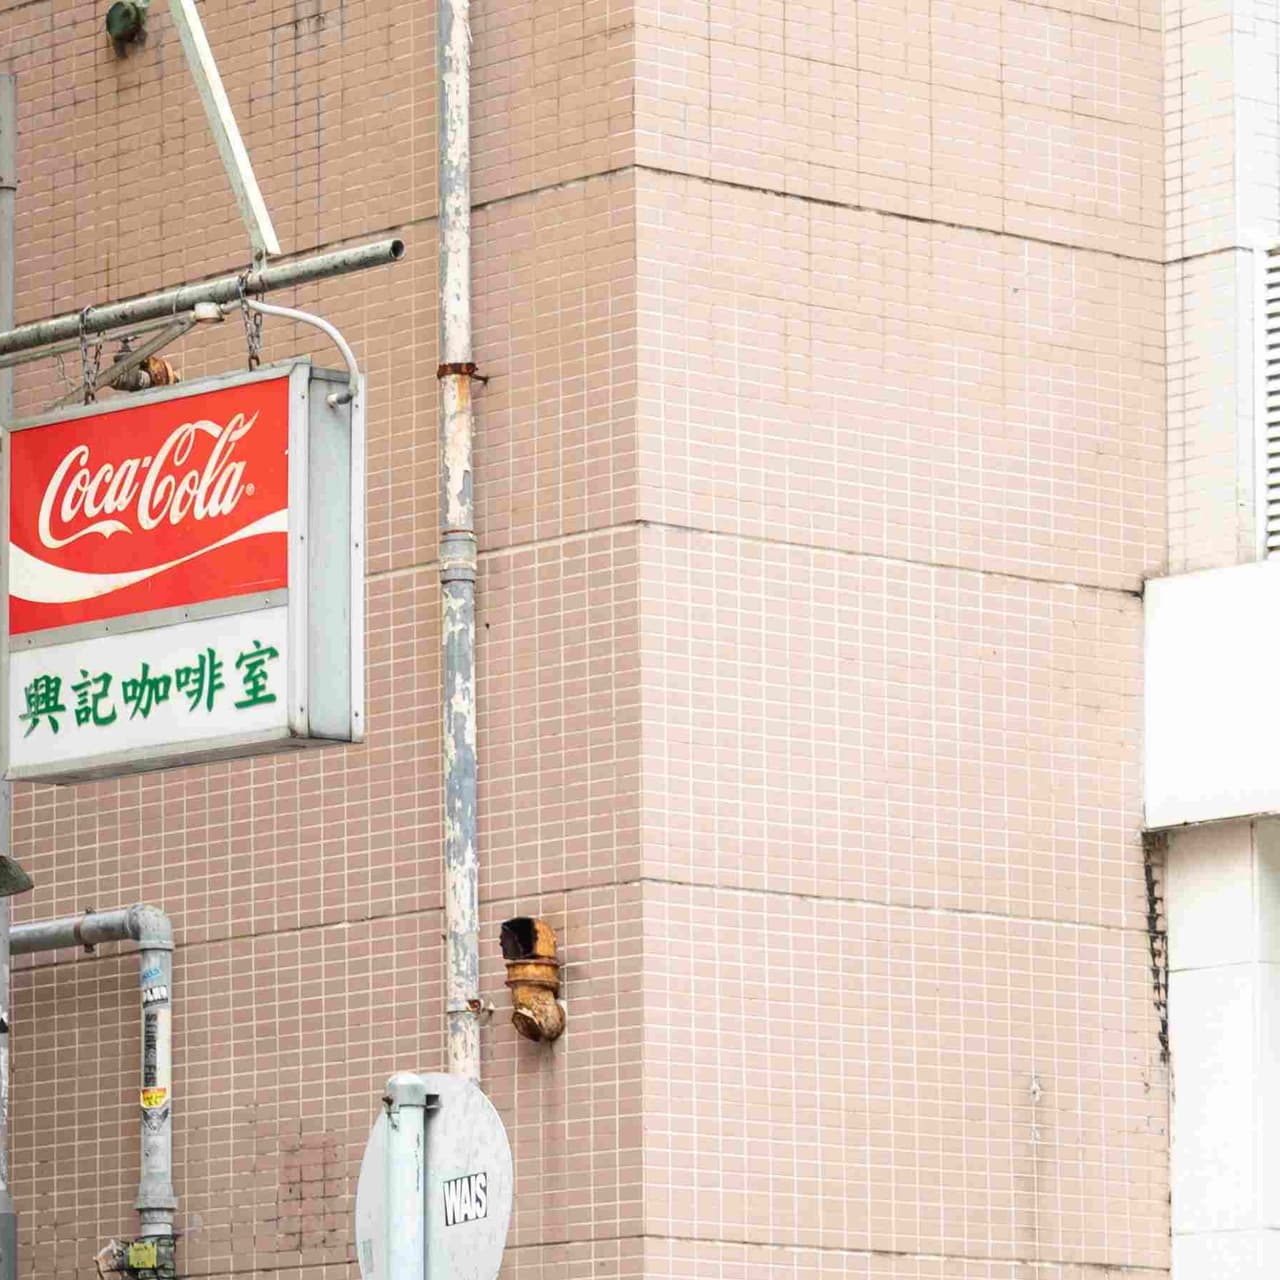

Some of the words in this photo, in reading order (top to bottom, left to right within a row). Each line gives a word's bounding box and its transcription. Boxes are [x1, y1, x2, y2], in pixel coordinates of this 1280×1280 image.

[37, 409, 260, 550] Coca-Cola
[18, 639, 281, 738] 興記咖啡室
